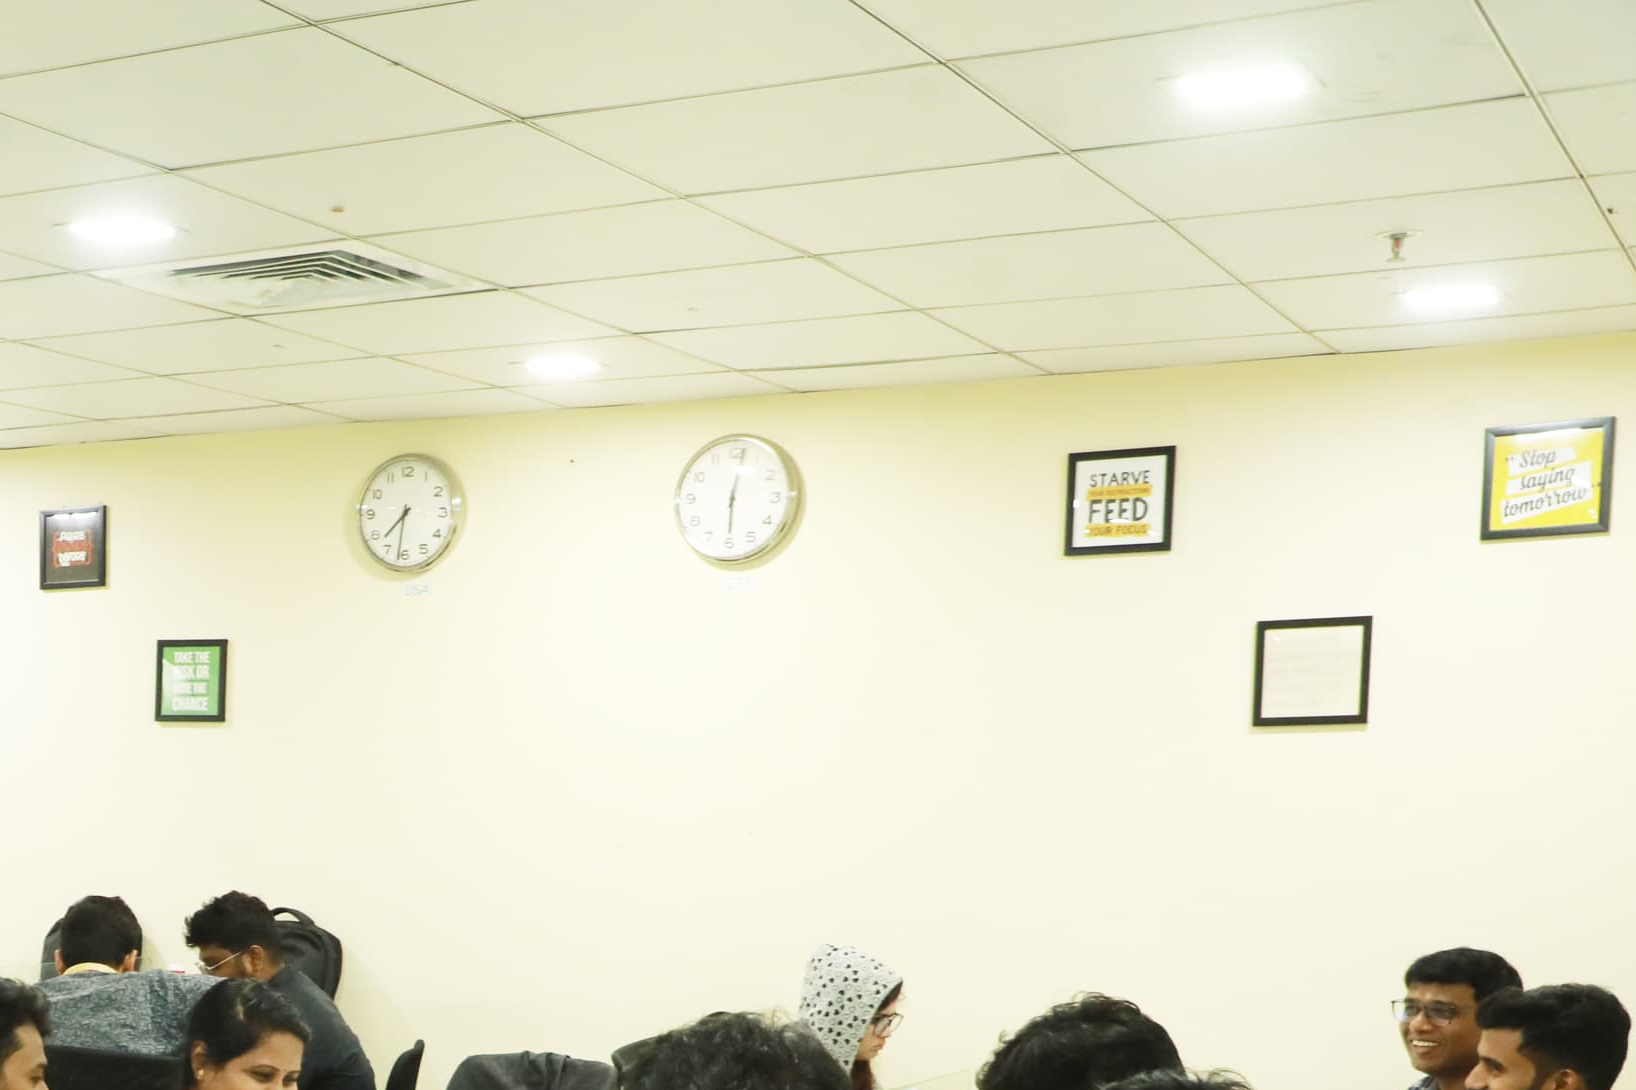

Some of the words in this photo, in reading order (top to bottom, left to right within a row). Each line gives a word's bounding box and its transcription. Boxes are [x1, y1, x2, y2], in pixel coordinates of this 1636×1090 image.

[1519, 449, 1557, 468] Stop
[387, 472, 395, 484] 11
[402, 466, 415, 478] 12
[1089, 470, 1151, 488] STARVE
[1519, 467, 1576, 493] saying
[372, 488, 383, 500] 10
[433, 486, 444, 497] 2
[770, 491, 781, 504] 3
[1503, 487, 1588, 518] tomorrow
[366, 508, 376, 520] 9
[437, 506, 448, 519] 3
[1088, 497, 1149, 524] FEED
[762, 515, 773, 525] 4
[370, 529, 381, 541] 8
[432, 528, 442, 538] 4
[1115, 524, 1148, 536] FOCUS
[746, 531, 757, 543] 5
[383, 544, 392, 555] 7
[400, 549, 410, 561] 6
[419, 543, 429, 555] 5
